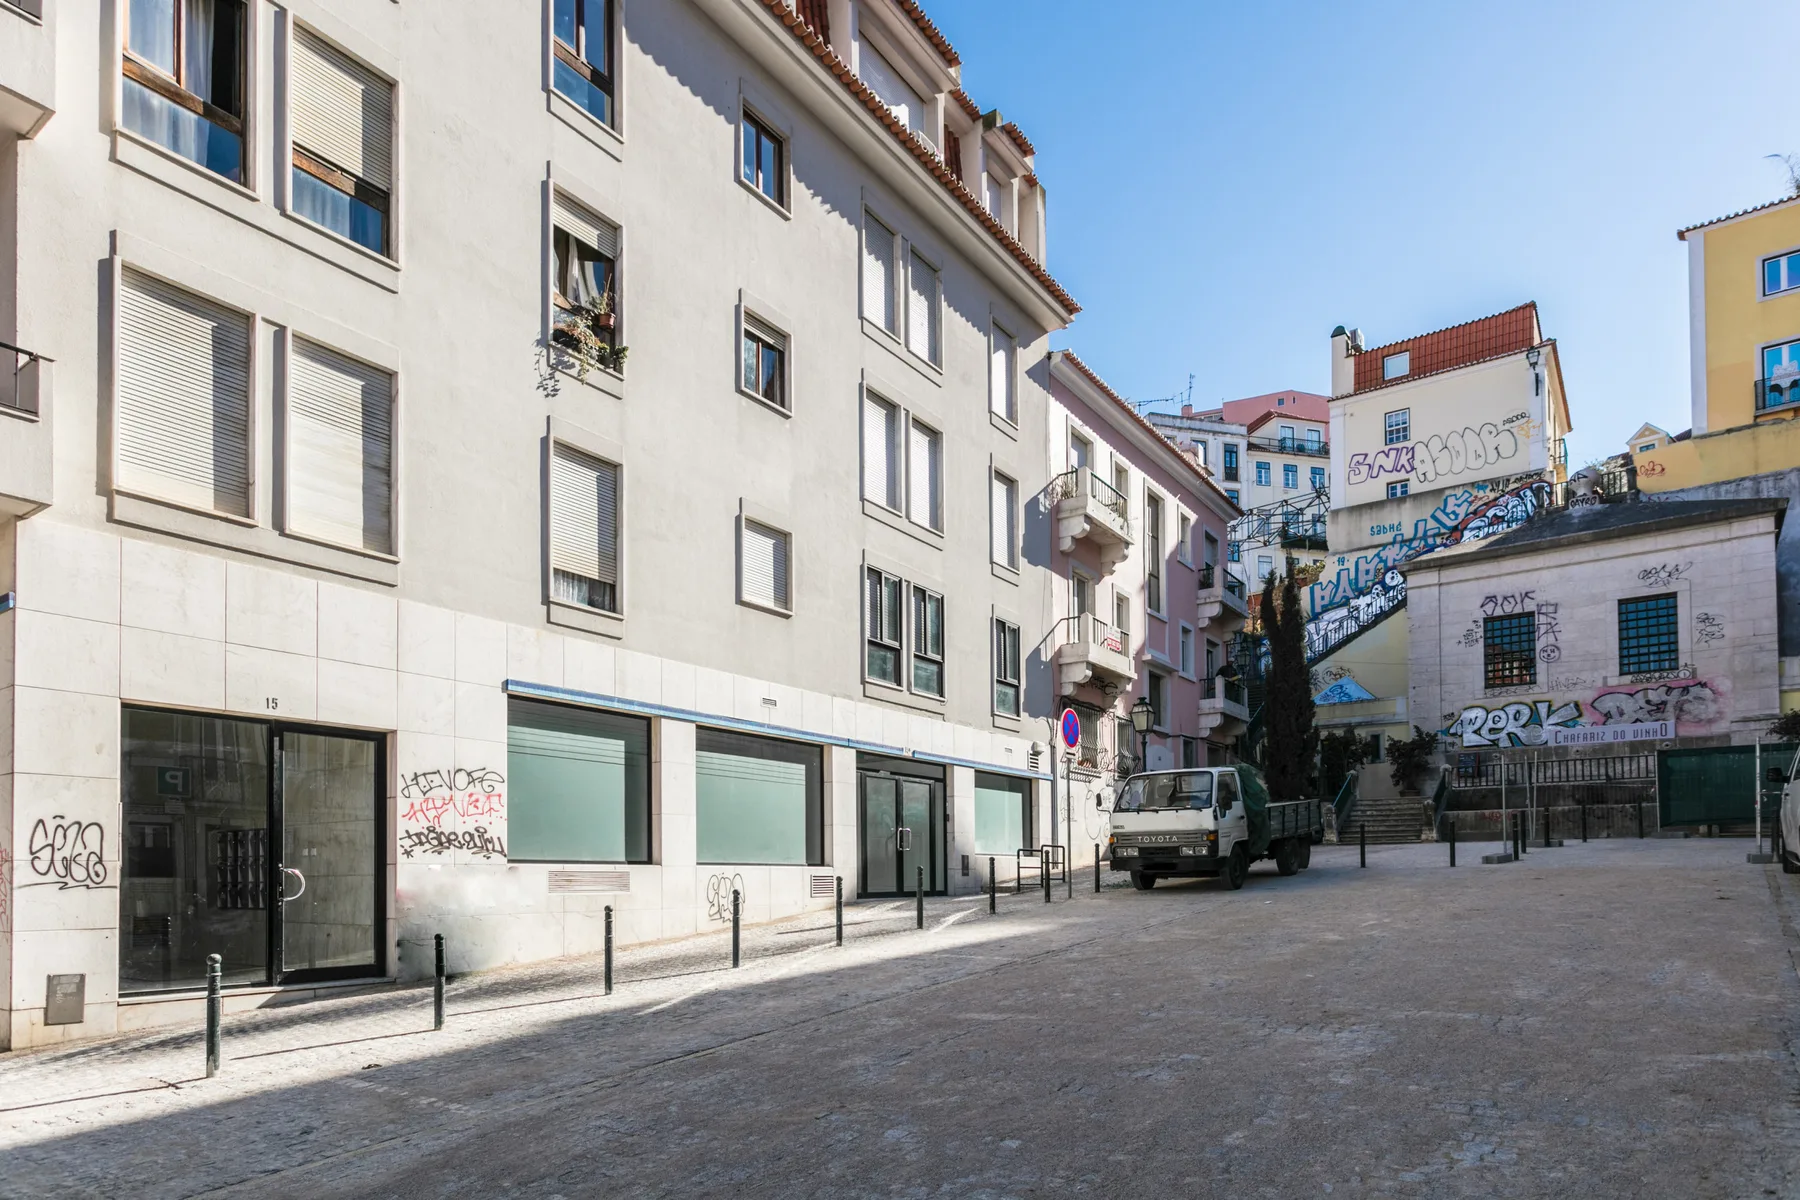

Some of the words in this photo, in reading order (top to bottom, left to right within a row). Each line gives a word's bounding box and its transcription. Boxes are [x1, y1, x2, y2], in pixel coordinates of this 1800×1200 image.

[266, 697, 278, 710] 15
[1555, 730, 1606, 744] CHAFARIZ
[1613, 730, 1626, 740] DO
[1137, 835, 1179, 843] TOYOTA
